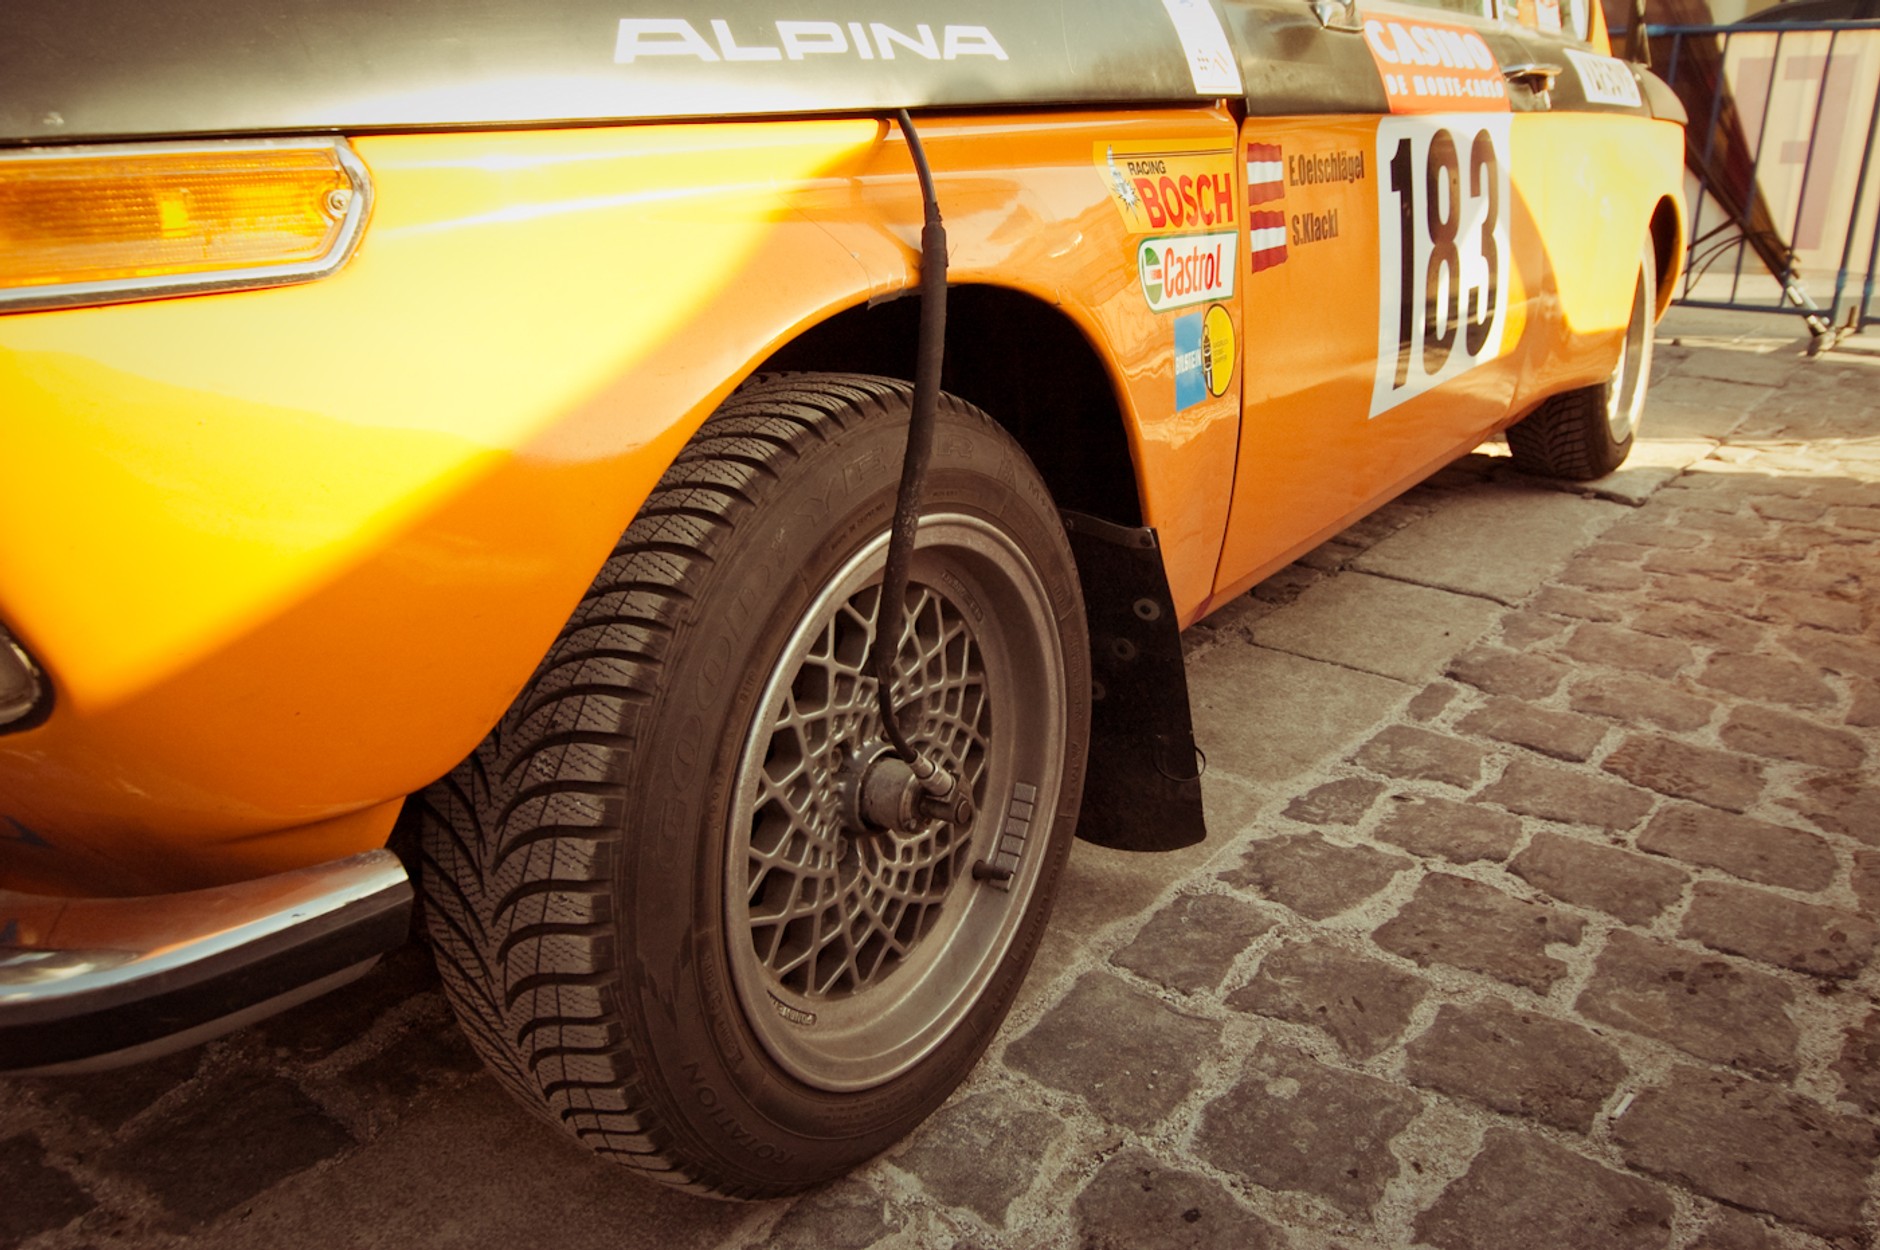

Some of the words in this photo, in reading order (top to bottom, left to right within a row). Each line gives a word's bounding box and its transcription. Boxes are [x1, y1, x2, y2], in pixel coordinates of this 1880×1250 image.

[614, 19, 1009, 63] ALPINA
[1364, 19, 1493, 71] CASINO
[1384, 73, 1409, 95] DE
[1412, 75, 1505, 98] MONTE-CARLO
[1127, 160, 1167, 176] RACING
[1288, 150, 1365, 187] E.Oelschlägel
[1133, 172, 1234, 229] BOSCH
[1291, 208, 1339, 247] S.Klackl
[1163, 243, 1222, 299] Castrol
[1389, 128, 1499, 392] 183
[681, 1060, 794, 1164] ROTATION
